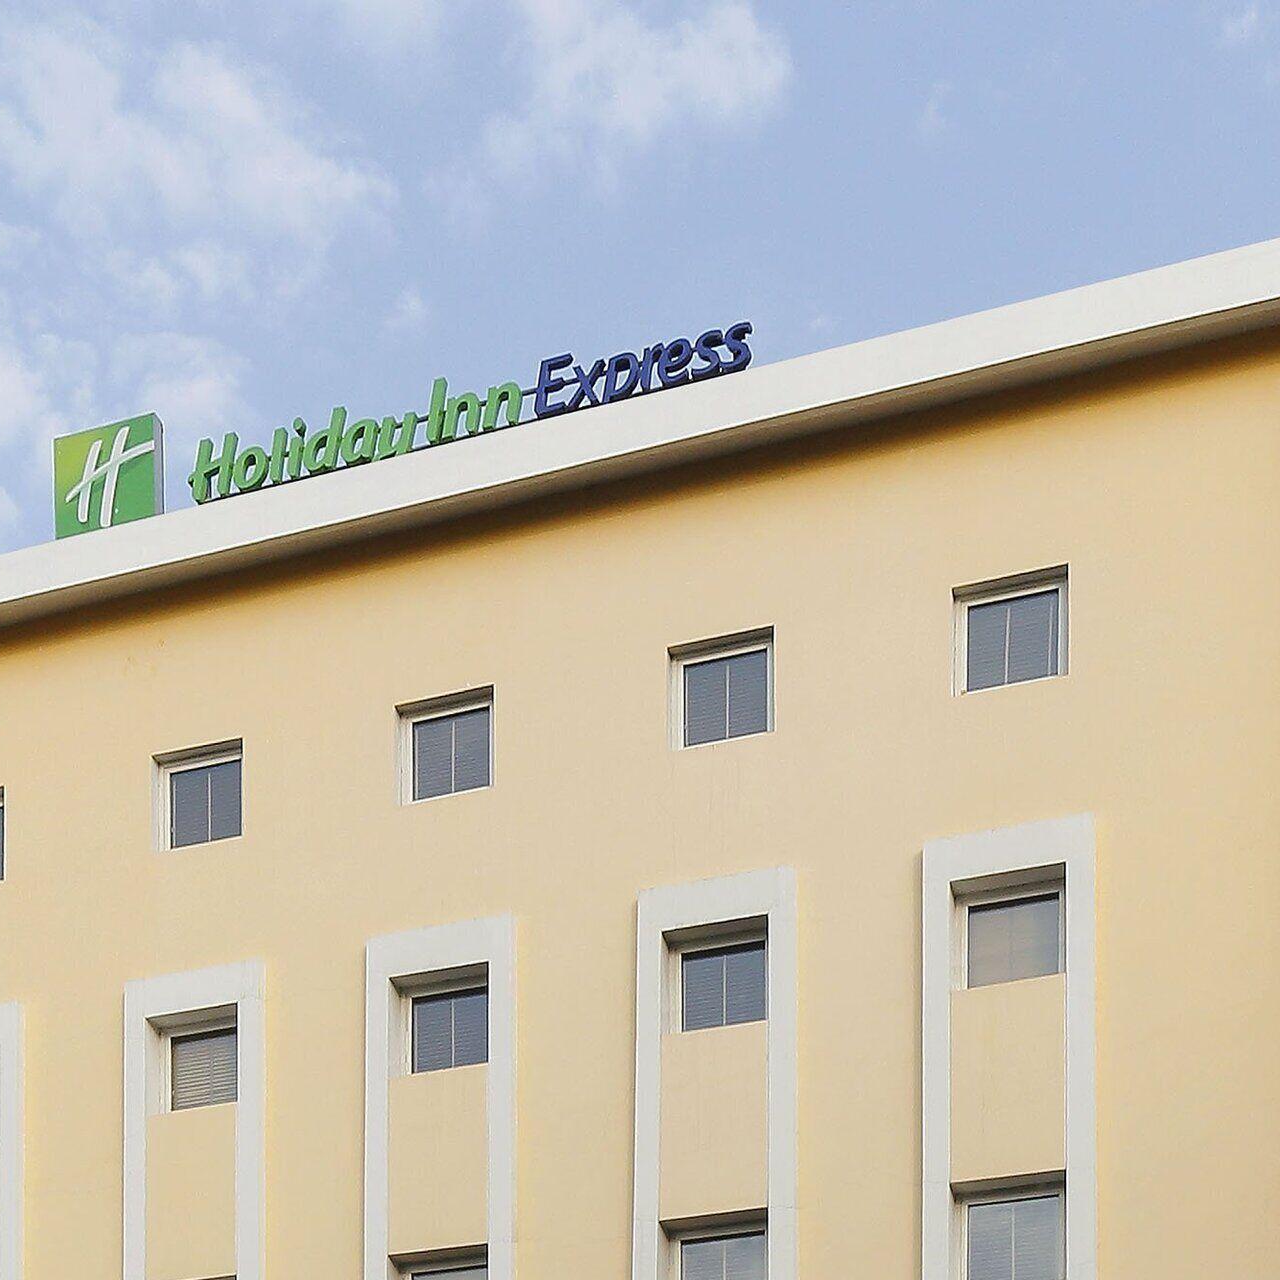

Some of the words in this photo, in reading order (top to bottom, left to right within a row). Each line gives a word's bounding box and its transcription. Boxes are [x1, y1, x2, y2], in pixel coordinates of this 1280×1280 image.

[187, 406, 418, 504] Holiday
[426, 377, 522, 443] Inn
[534, 322, 753, 418] Express
